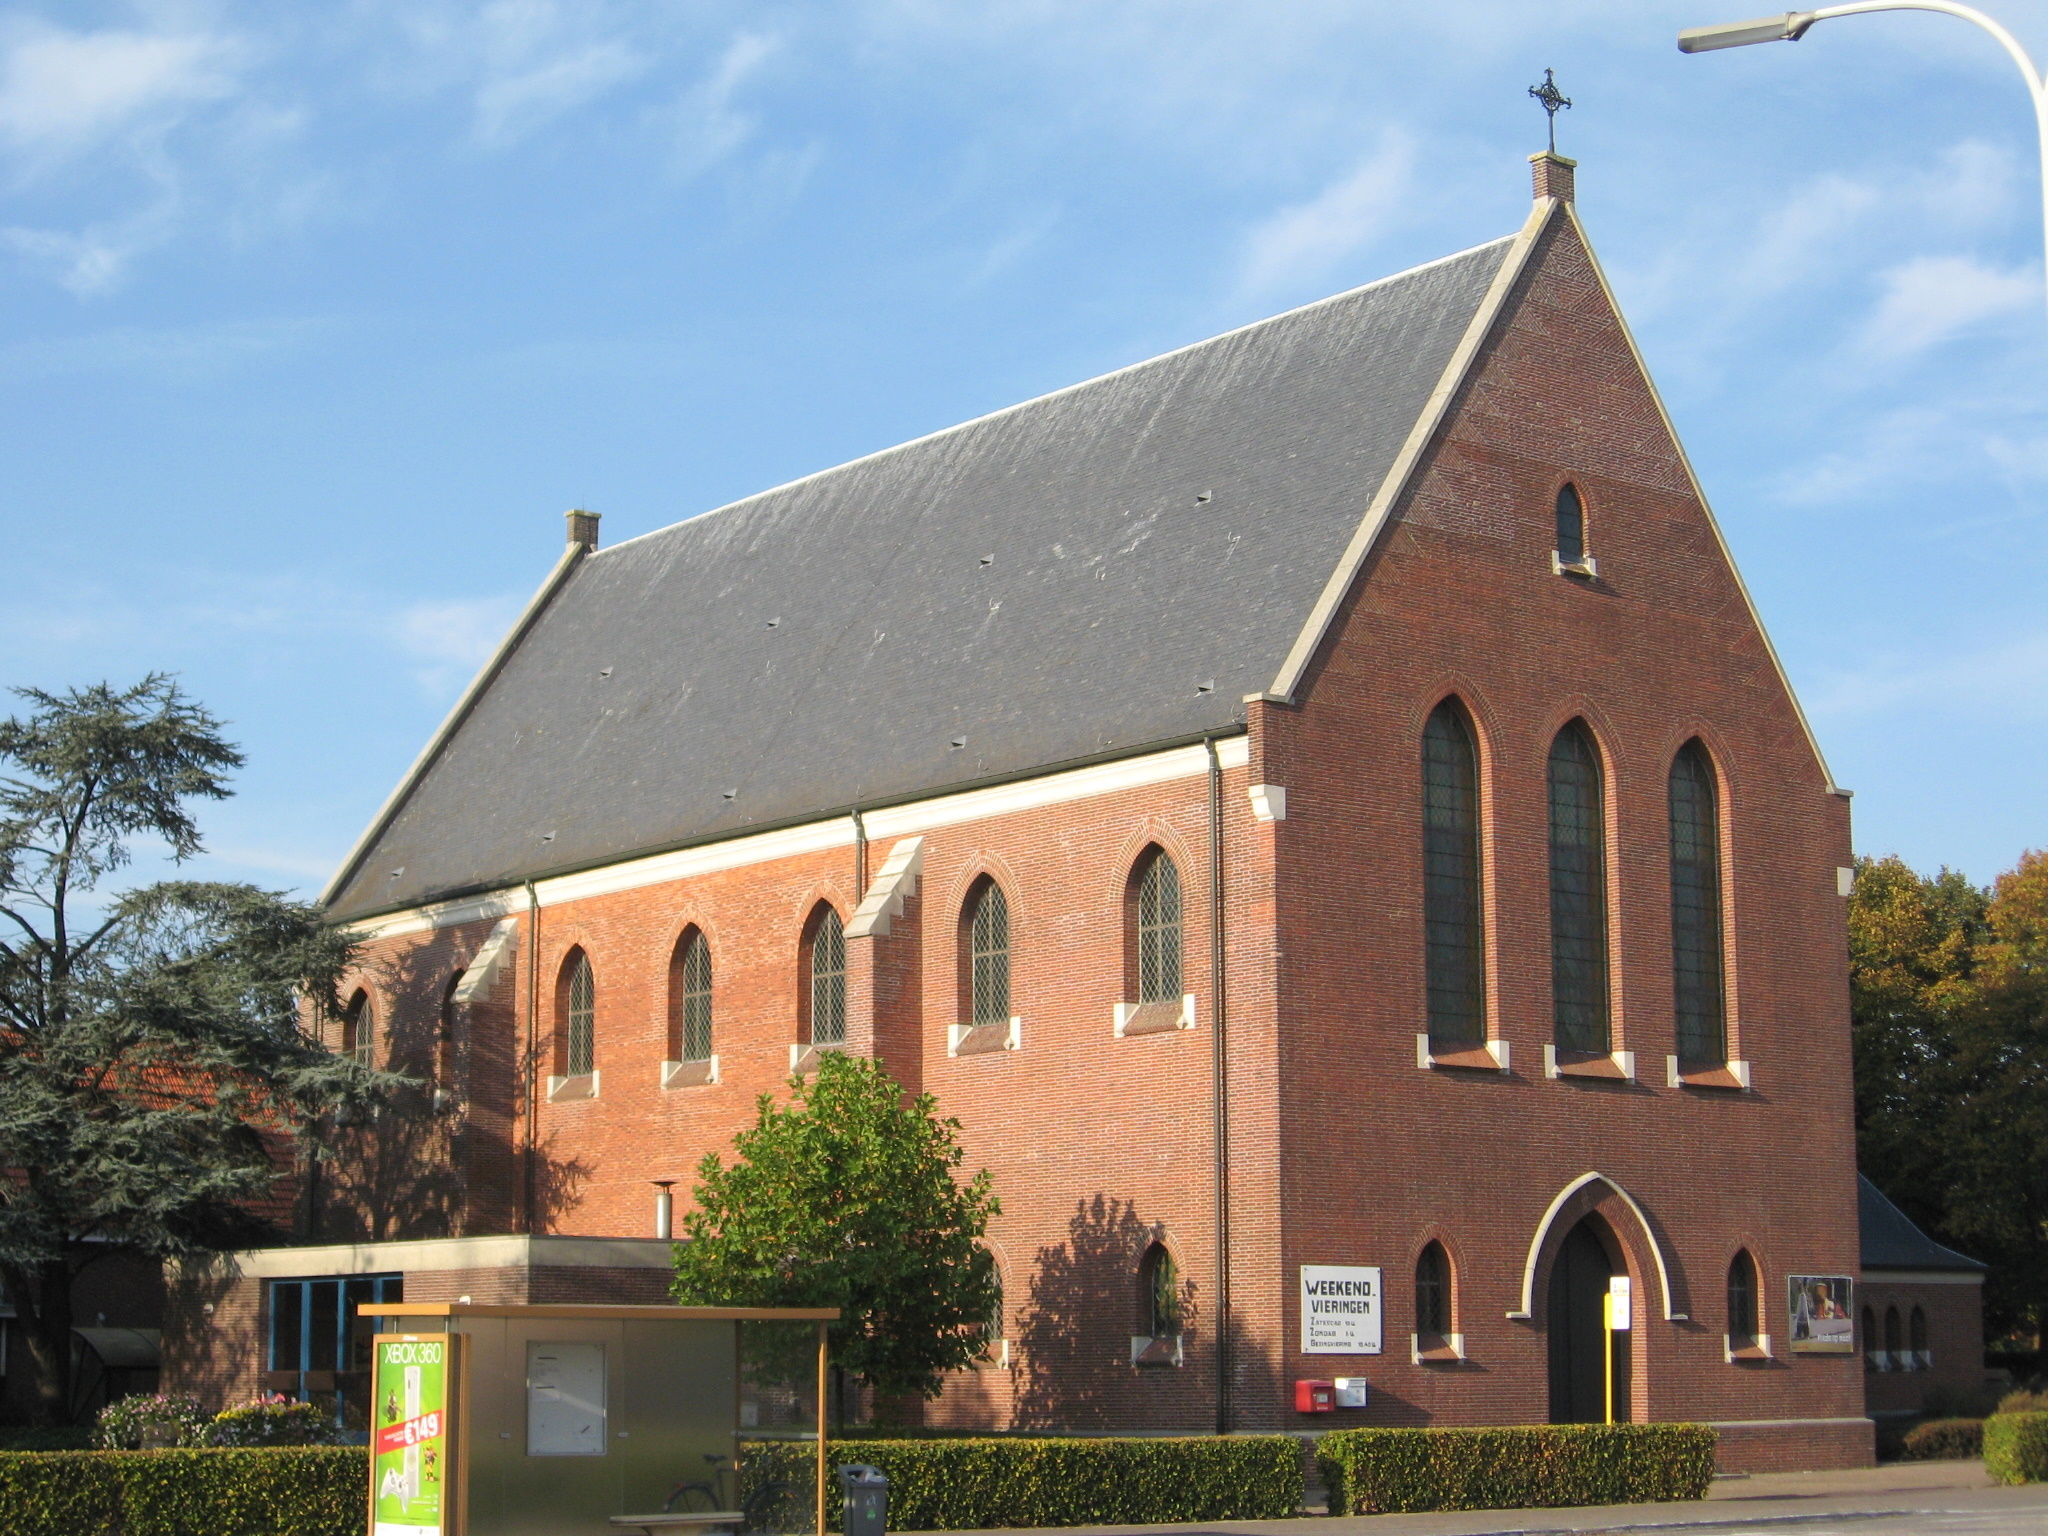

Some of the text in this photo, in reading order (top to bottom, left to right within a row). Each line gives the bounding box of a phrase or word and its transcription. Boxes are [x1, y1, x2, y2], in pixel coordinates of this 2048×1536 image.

[1312, 1299, 1370, 1314] VIERINGEN
[385, 1342, 442, 1364] XBOX 360
